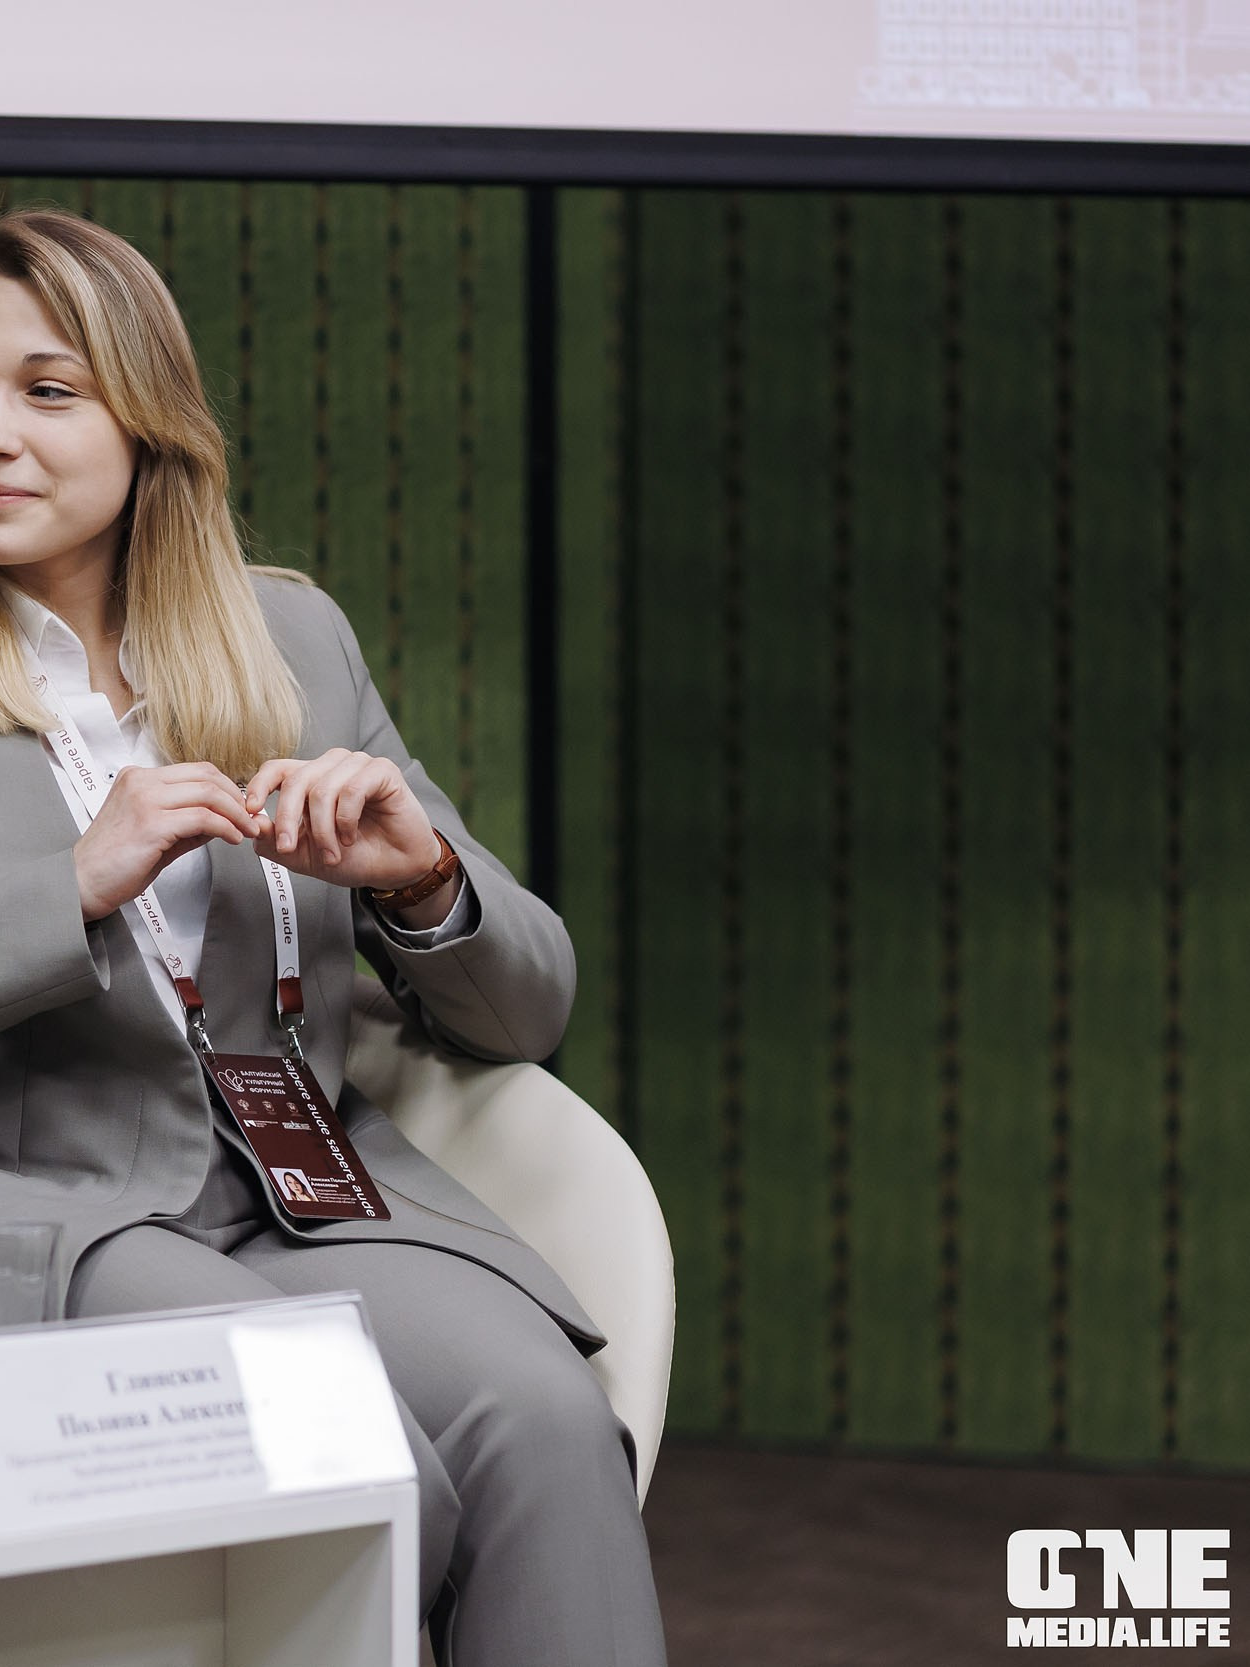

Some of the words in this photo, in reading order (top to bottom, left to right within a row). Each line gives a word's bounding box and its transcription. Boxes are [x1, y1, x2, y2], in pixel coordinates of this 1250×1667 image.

[68, 749, 97, 791] sapere
[270, 862, 287, 901] apere
[281, 907, 293, 945] aude
[282, 1057, 311, 1100] sapere
[307, 1103, 330, 1136] aude
[326, 1138, 356, 1182] sapere
[352, 1184, 376, 1217] aude
